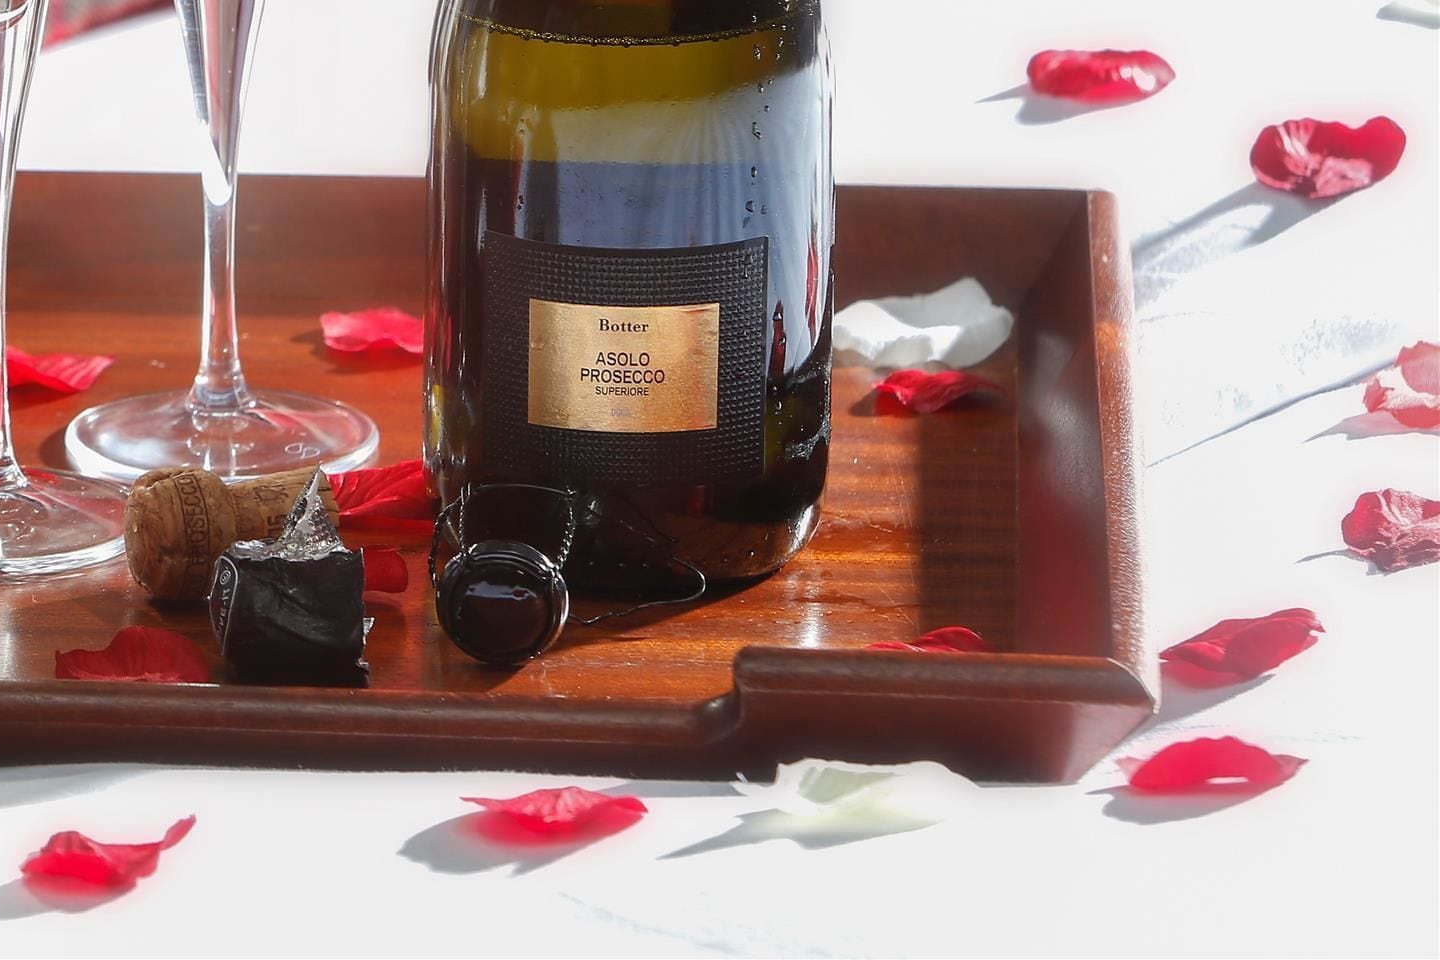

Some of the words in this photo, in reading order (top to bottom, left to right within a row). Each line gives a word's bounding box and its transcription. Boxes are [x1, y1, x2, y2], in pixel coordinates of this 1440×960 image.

[599, 319, 649, 333] Botter
[595, 352, 650, 367] ASOLO
[580, 368, 666, 385] PROSECCO
[595, 386, 650, 397] SUPERIORE
